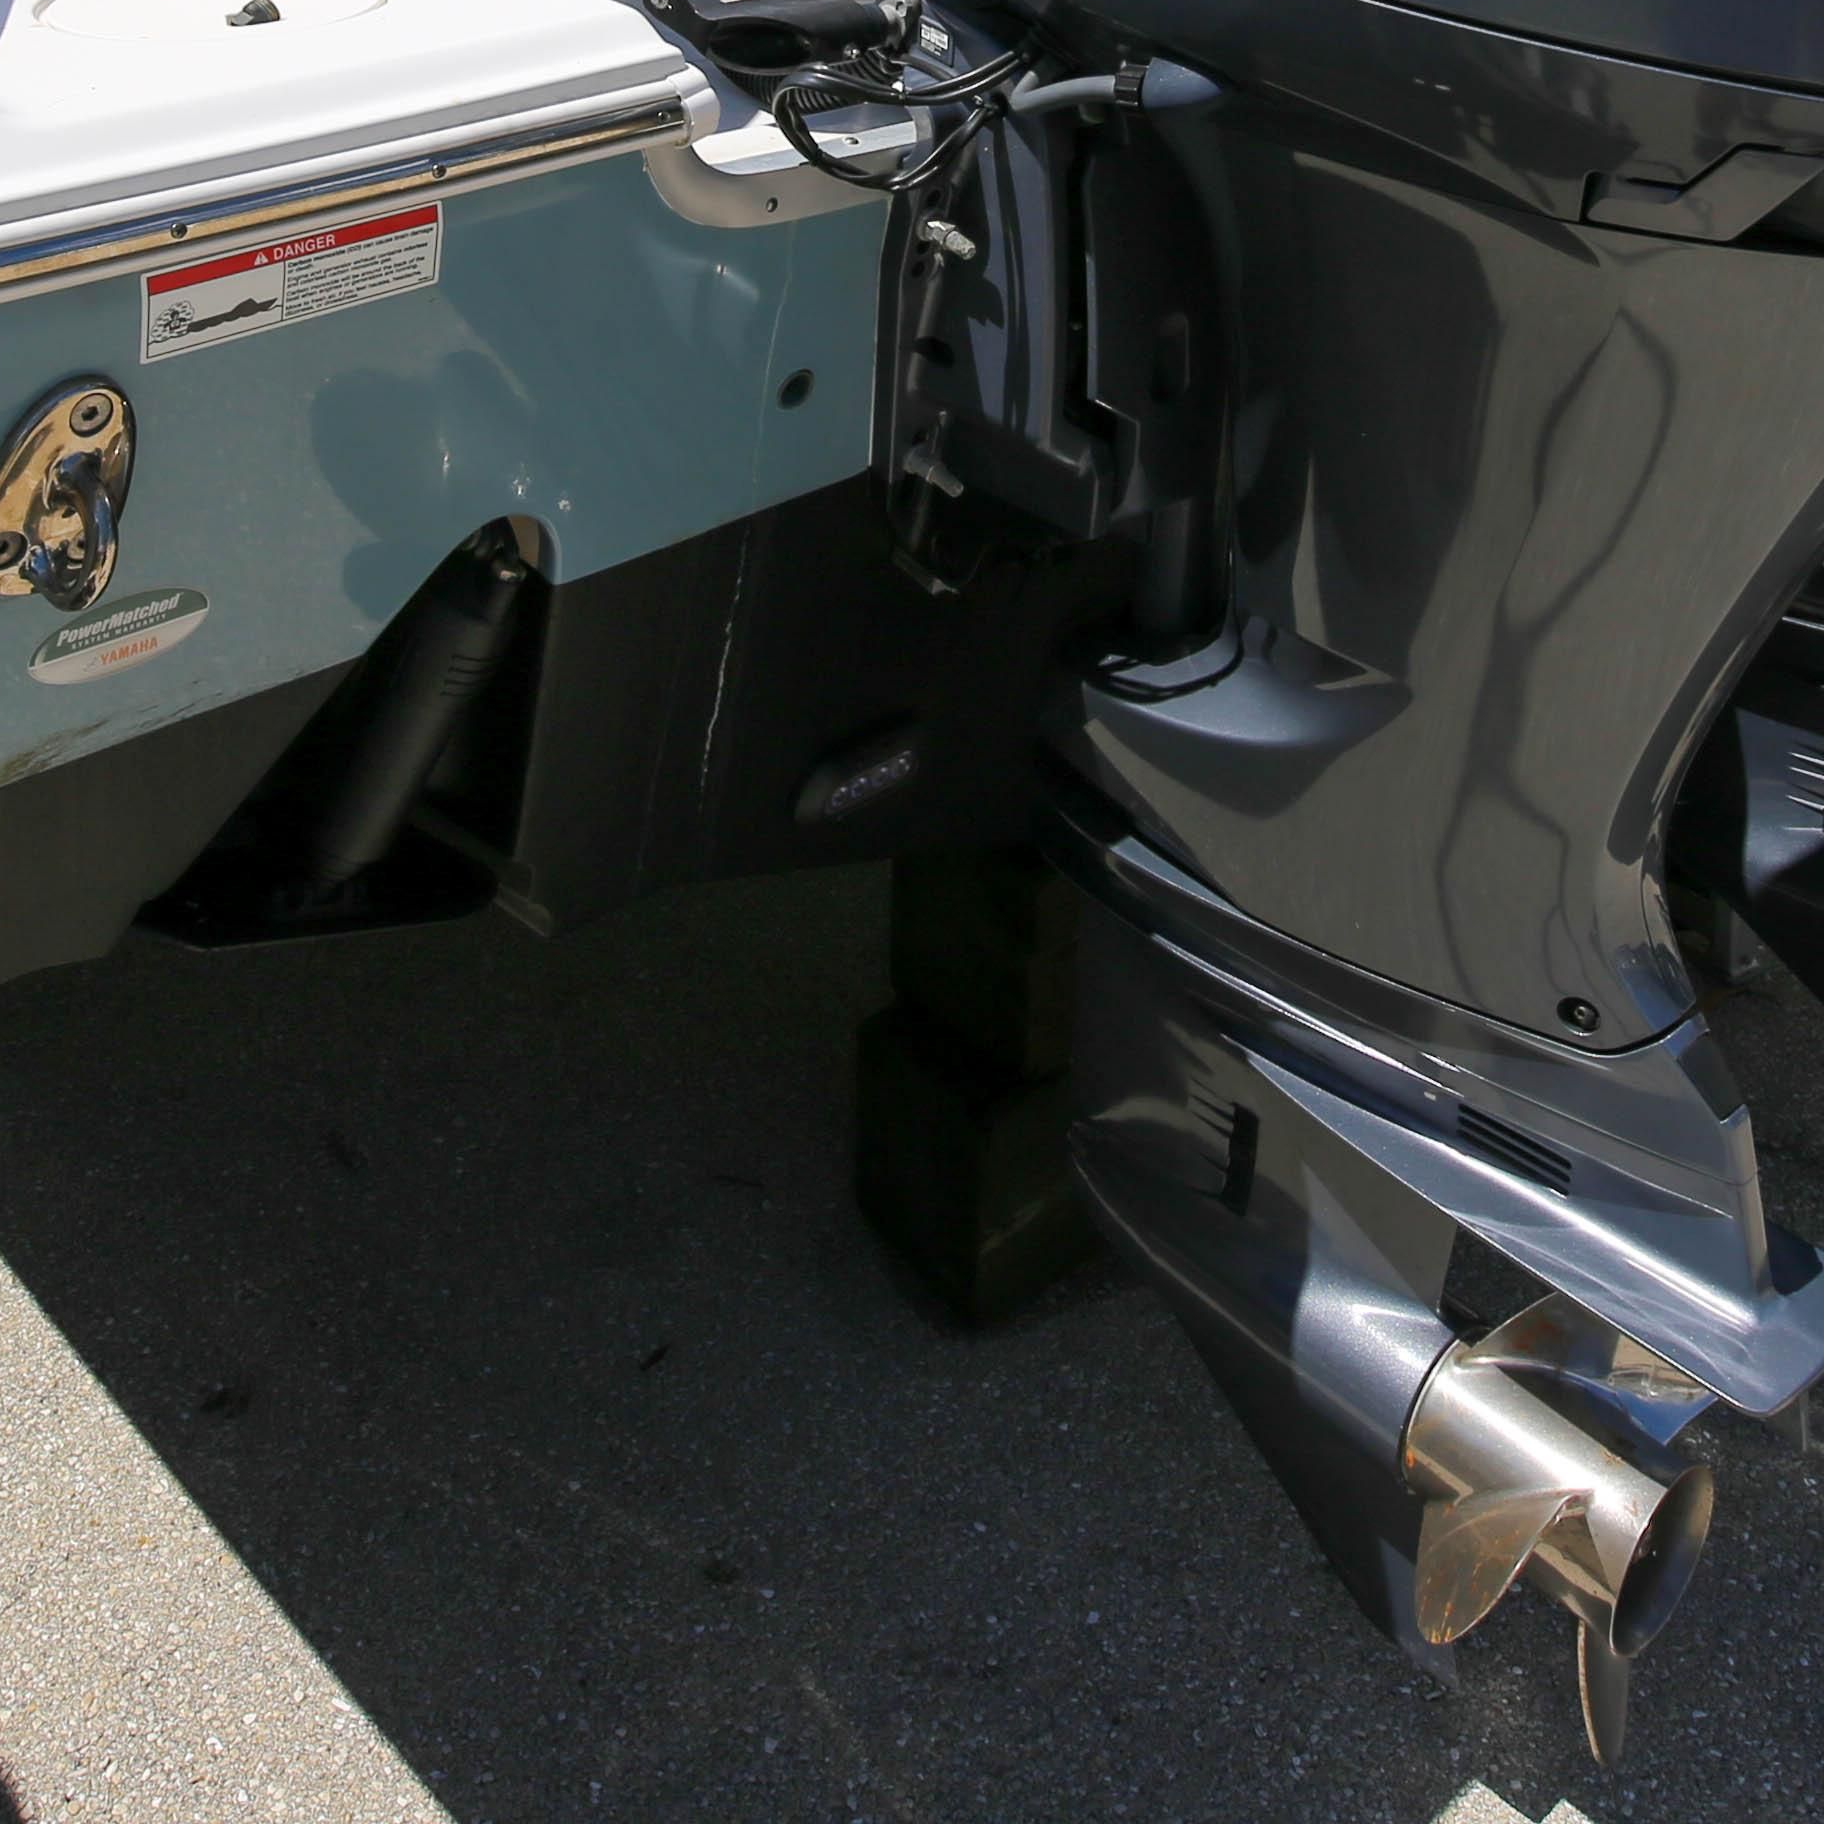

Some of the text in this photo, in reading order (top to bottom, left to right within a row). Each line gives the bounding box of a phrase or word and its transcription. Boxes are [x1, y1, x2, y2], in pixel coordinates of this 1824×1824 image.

[273, 234, 336, 260] DANGER
[56, 592, 181, 648] PowerMatched
[100, 636, 159, 665] YAMAHA
